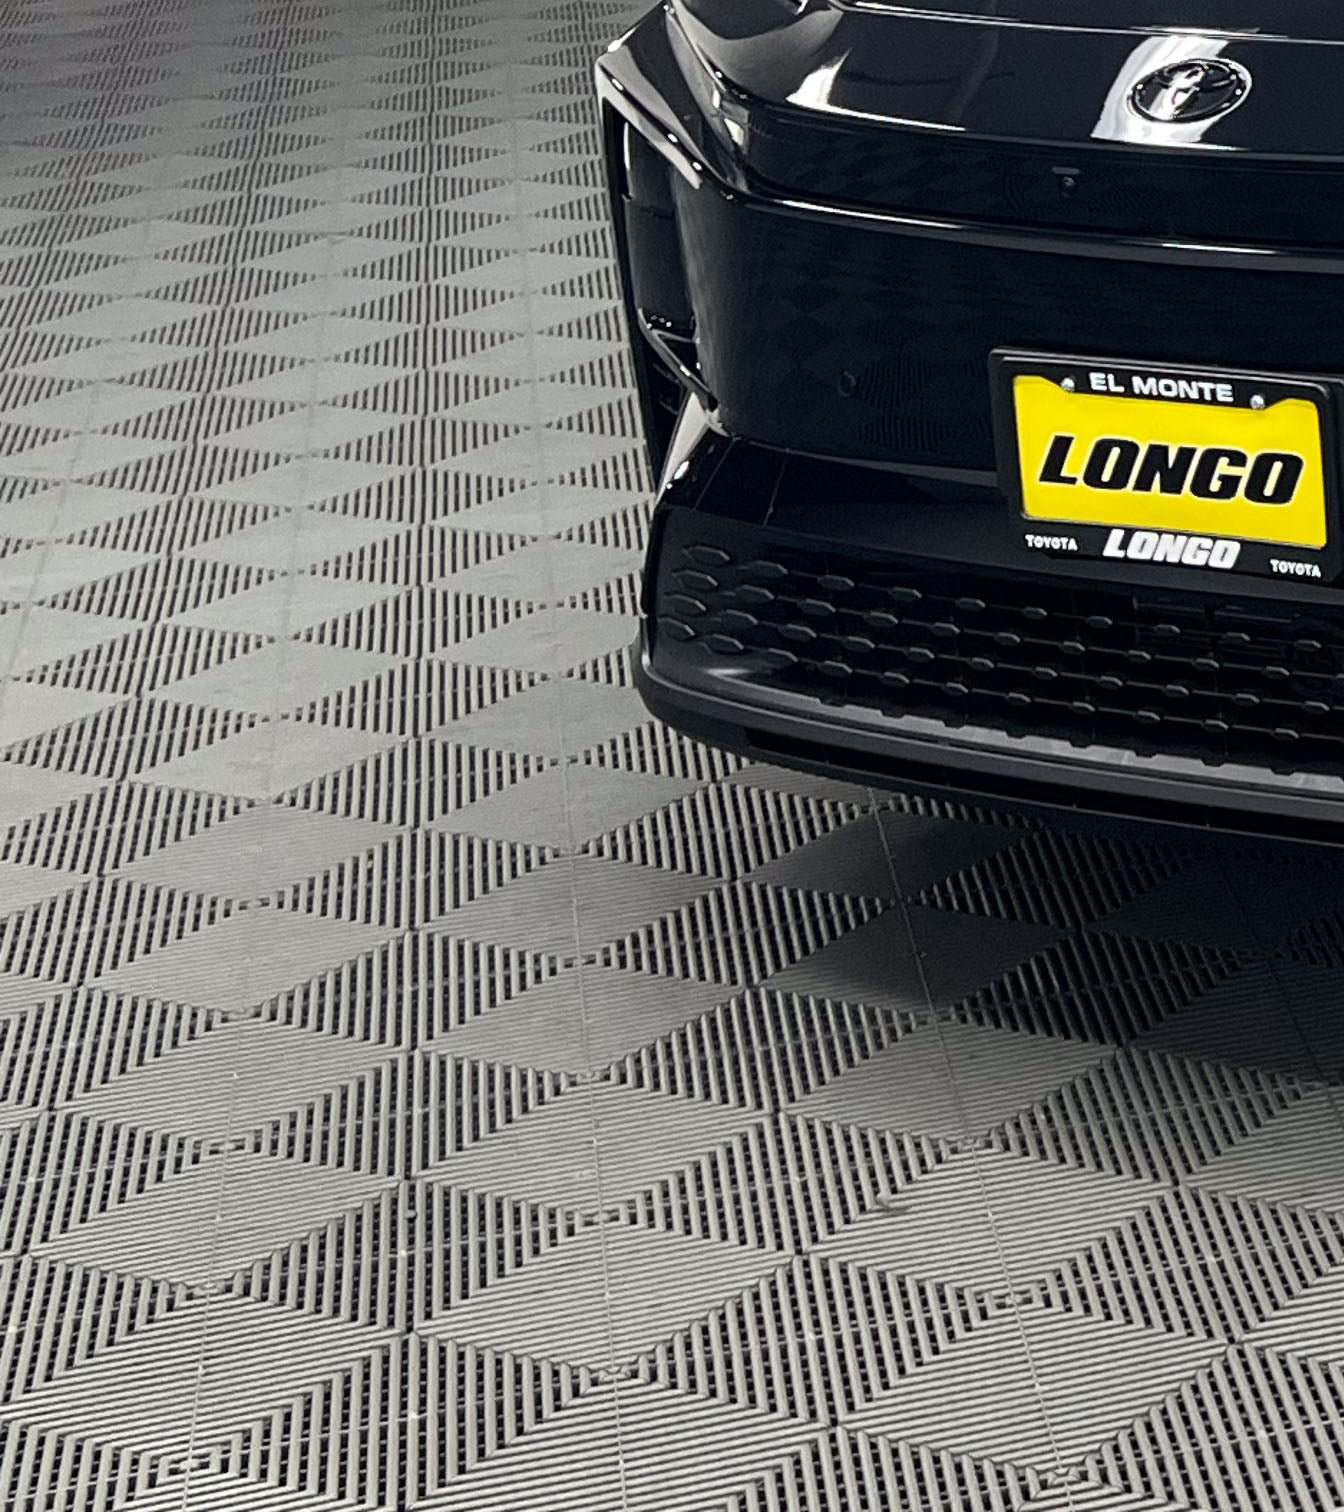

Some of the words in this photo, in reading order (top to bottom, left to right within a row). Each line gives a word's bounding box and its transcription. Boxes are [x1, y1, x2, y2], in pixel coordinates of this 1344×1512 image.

[1089, 372, 1126, 393] EL
[1133, 376, 1234, 403] MONTE
[1039, 435, 1304, 505] LONGO
[1025, 534, 1078, 551] TOYOTA
[1102, 529, 1241, 569] LONGO
[1270, 559, 1322, 578] TOYOTA
